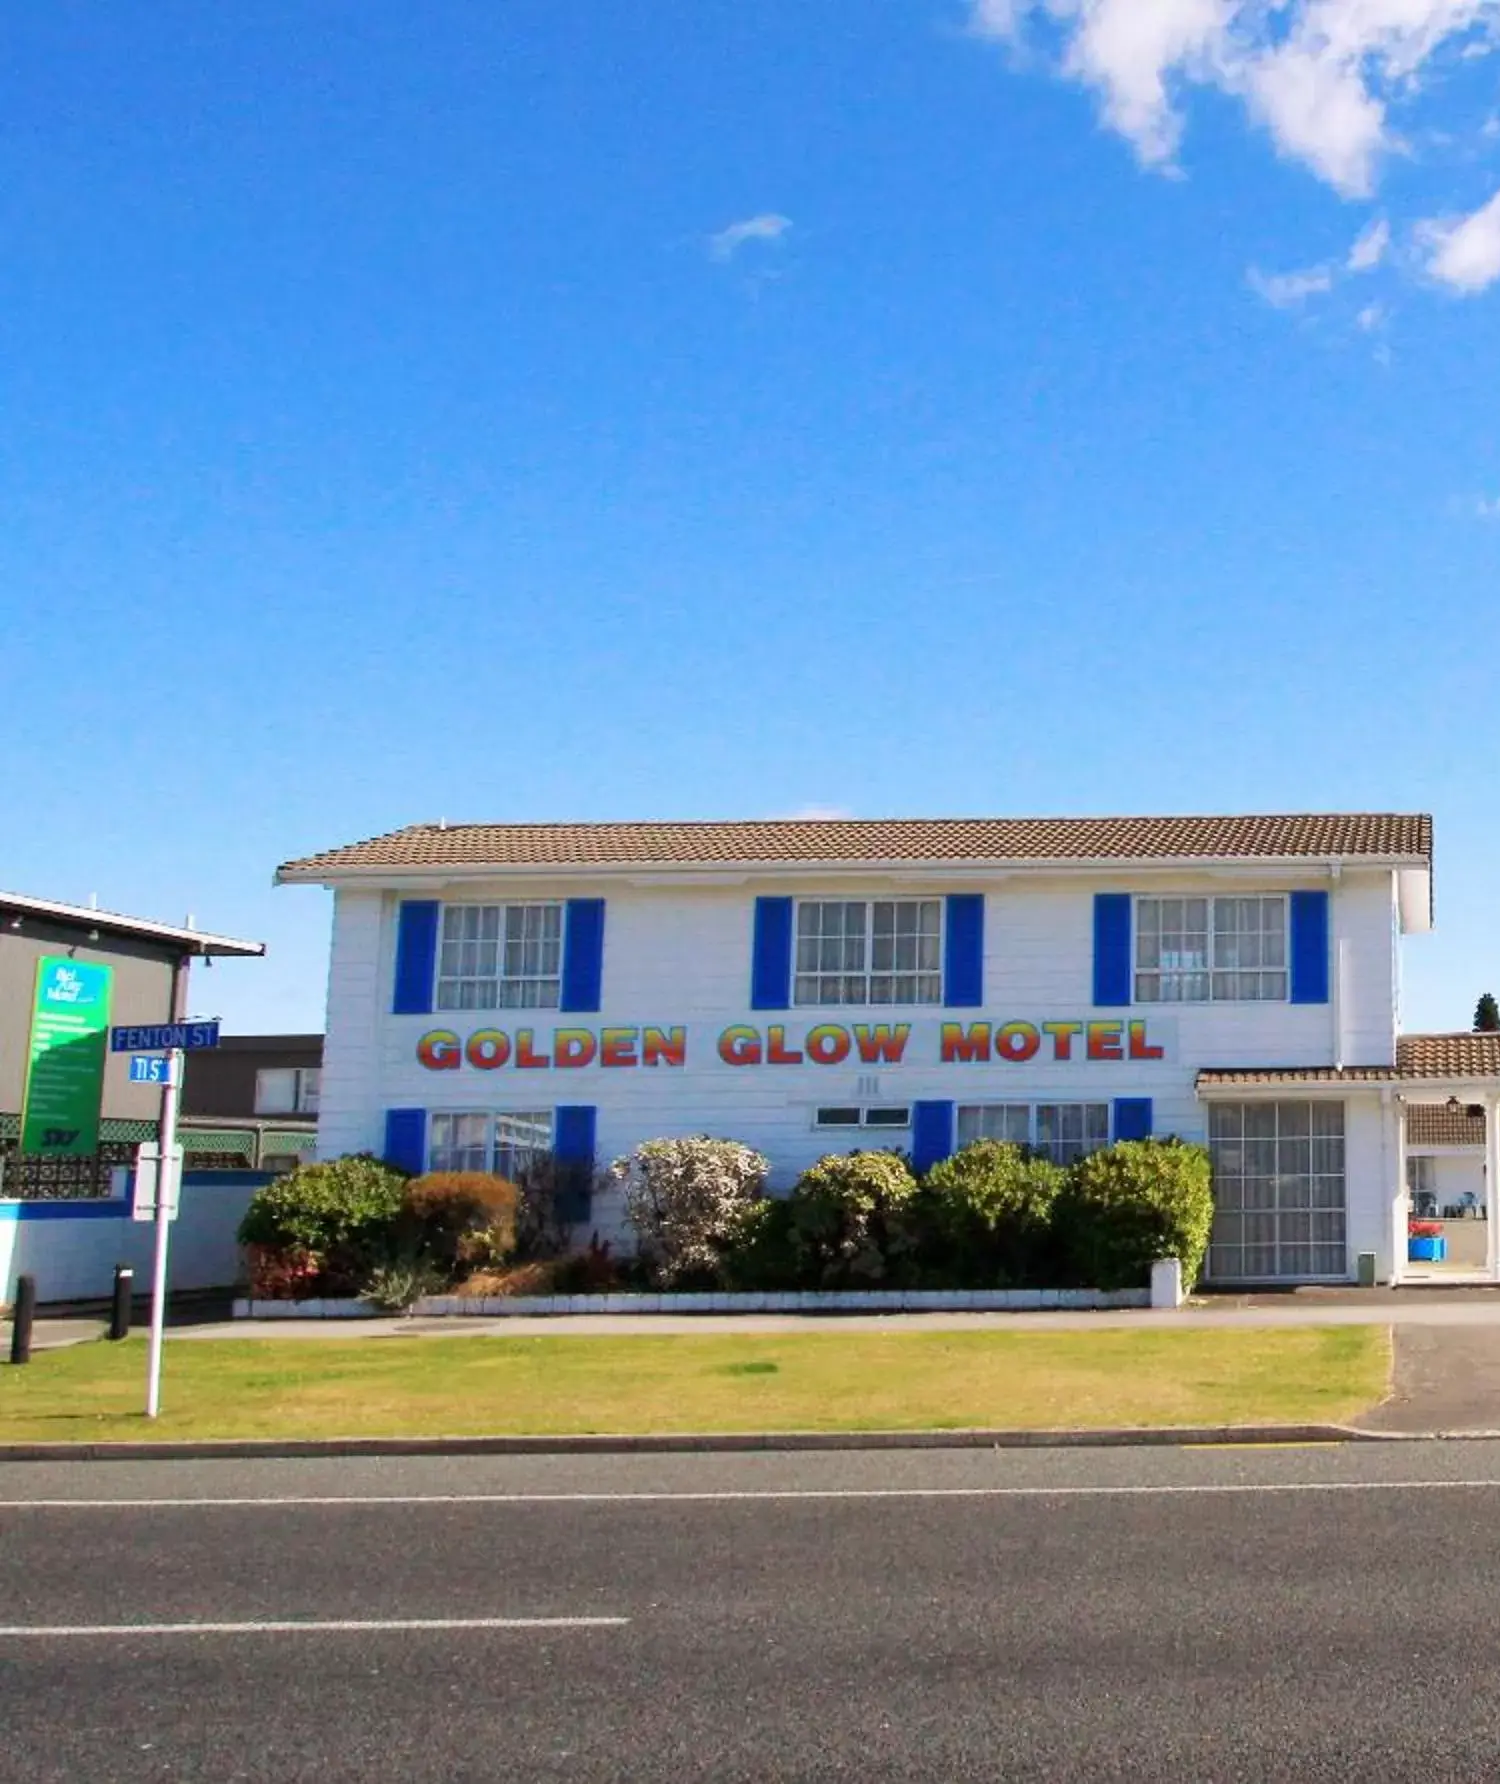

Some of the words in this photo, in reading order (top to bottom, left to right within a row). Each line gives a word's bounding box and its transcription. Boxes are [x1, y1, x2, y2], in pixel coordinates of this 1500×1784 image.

[116, 1026, 187, 1049] FENTON
[191, 1024, 214, 1046] ST
[417, 1027, 688, 1070] GOLDEN
[717, 1023, 911, 1066] GLOW
[940, 1019, 1165, 1063] MOTEL
